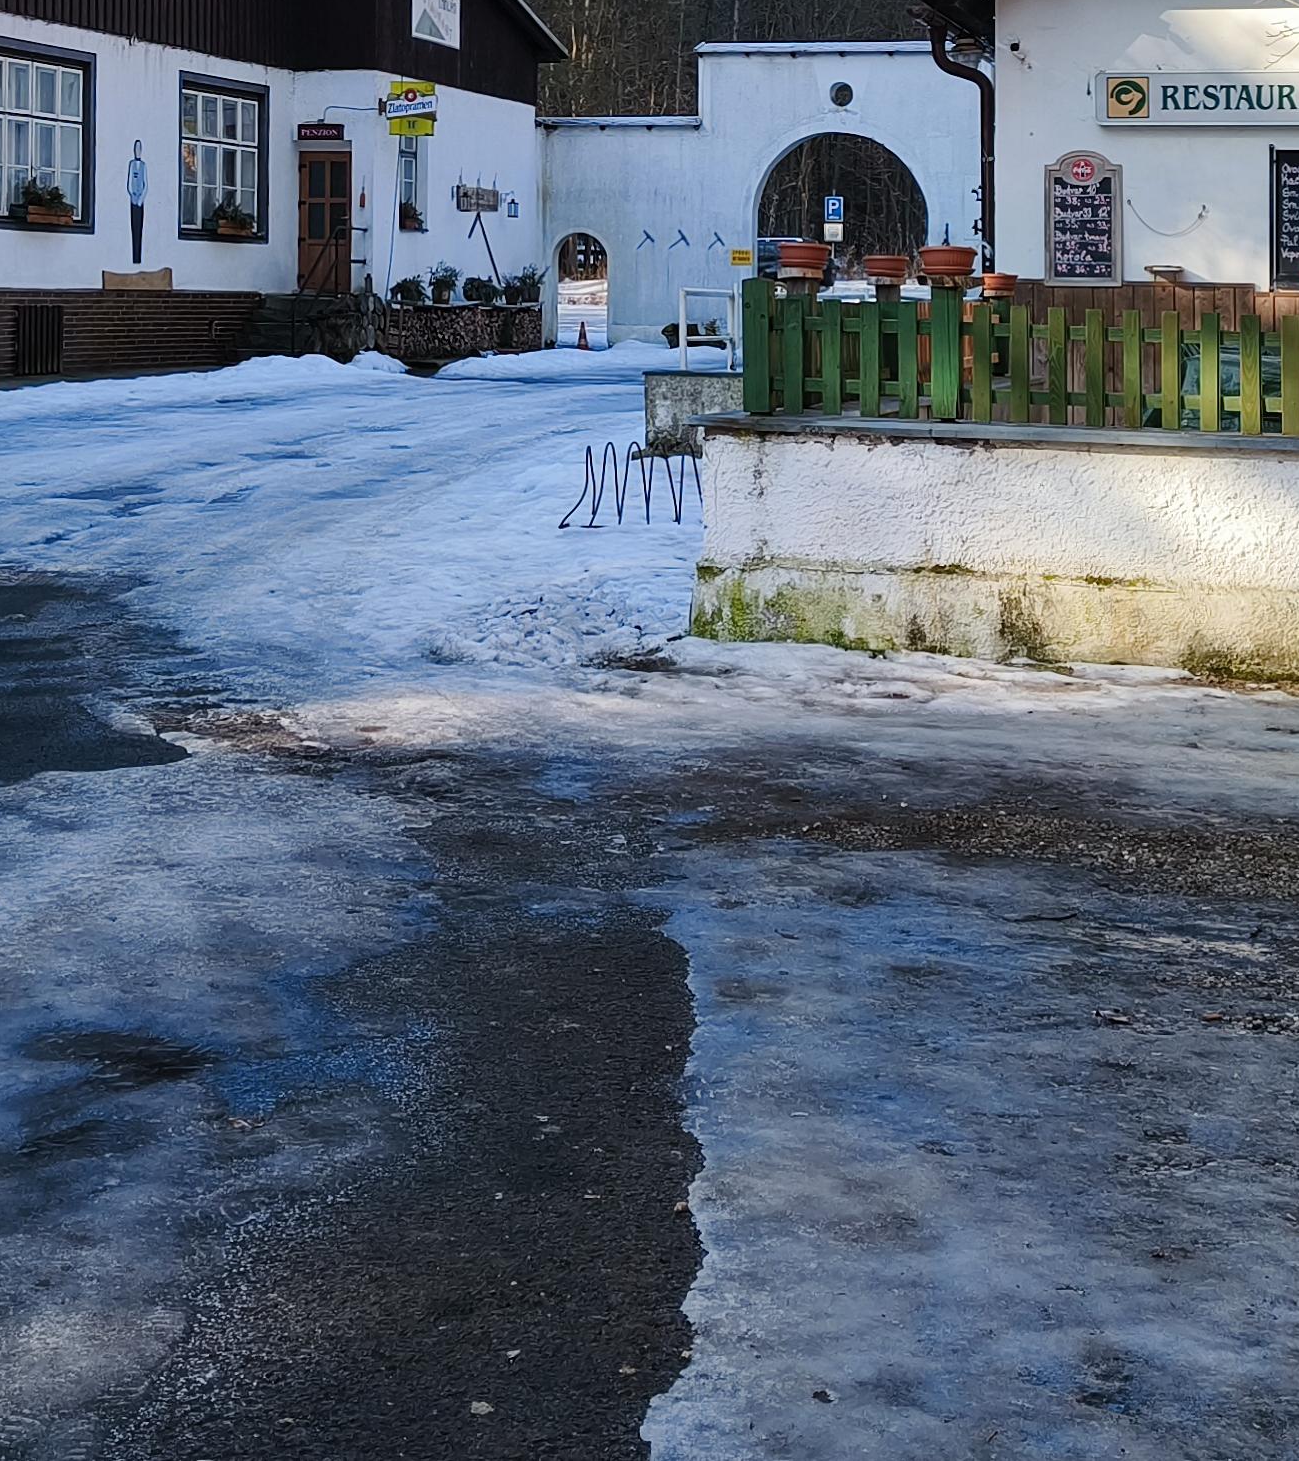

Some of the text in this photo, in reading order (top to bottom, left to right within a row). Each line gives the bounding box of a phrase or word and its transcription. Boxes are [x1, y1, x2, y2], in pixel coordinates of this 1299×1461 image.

[387, 99, 433, 114] Zlatopramen
[301, 127, 338, 136] PENZION
[828, 199, 839, 215] P
[1055, 250, 1093, 262] Kofola
